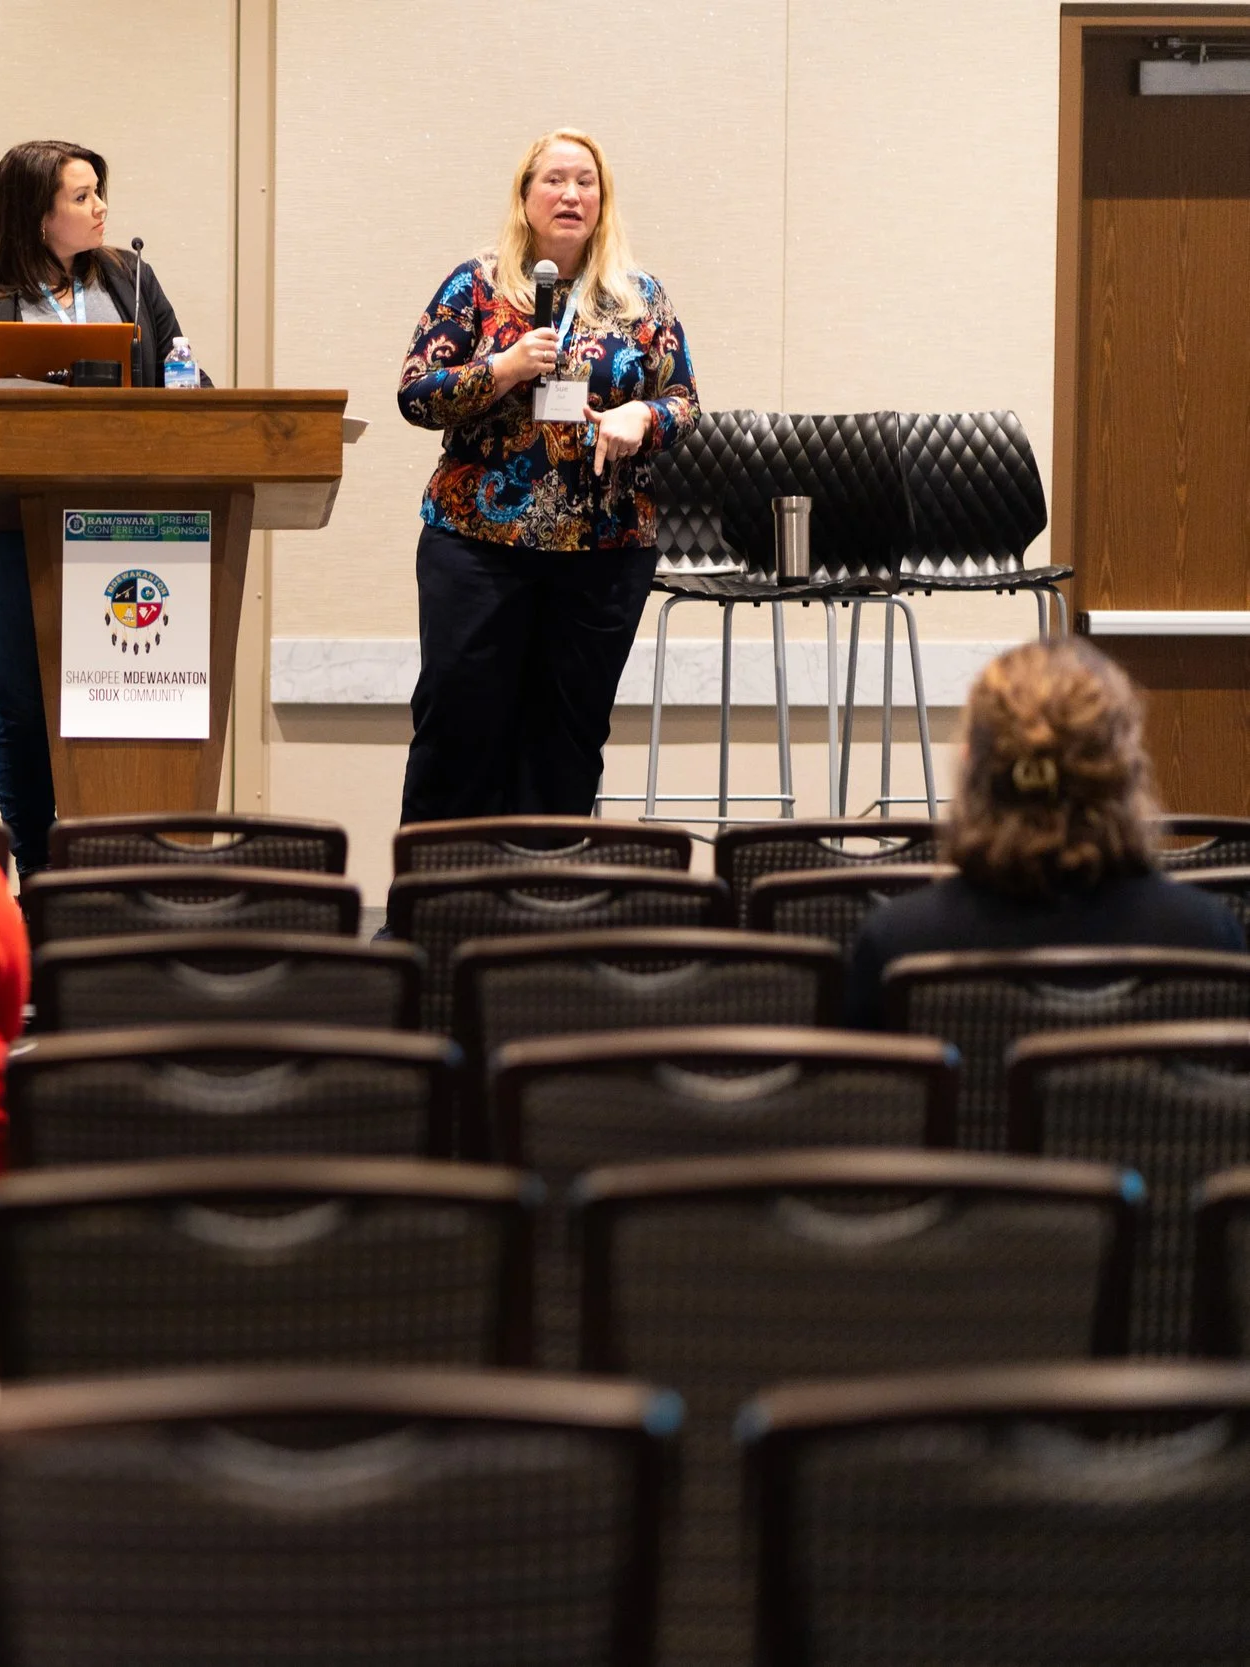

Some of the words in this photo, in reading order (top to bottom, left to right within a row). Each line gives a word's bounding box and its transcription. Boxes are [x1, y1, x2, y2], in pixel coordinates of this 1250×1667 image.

[87, 516, 155, 525] RAM/SWANA
[162, 515, 207, 524] PREMIER
[87, 526, 155, 535] CONFERENCE
[160, 526, 210, 535] SPONSOR
[107, 570, 168, 595] MDEWAKANTON
[65, 671, 120, 684] SHAKOPEE
[123, 671, 207, 685] MDEWAKANTON
[88, 688, 120, 702] SIOUX
[123, 689, 185, 702] COMMUNITY
